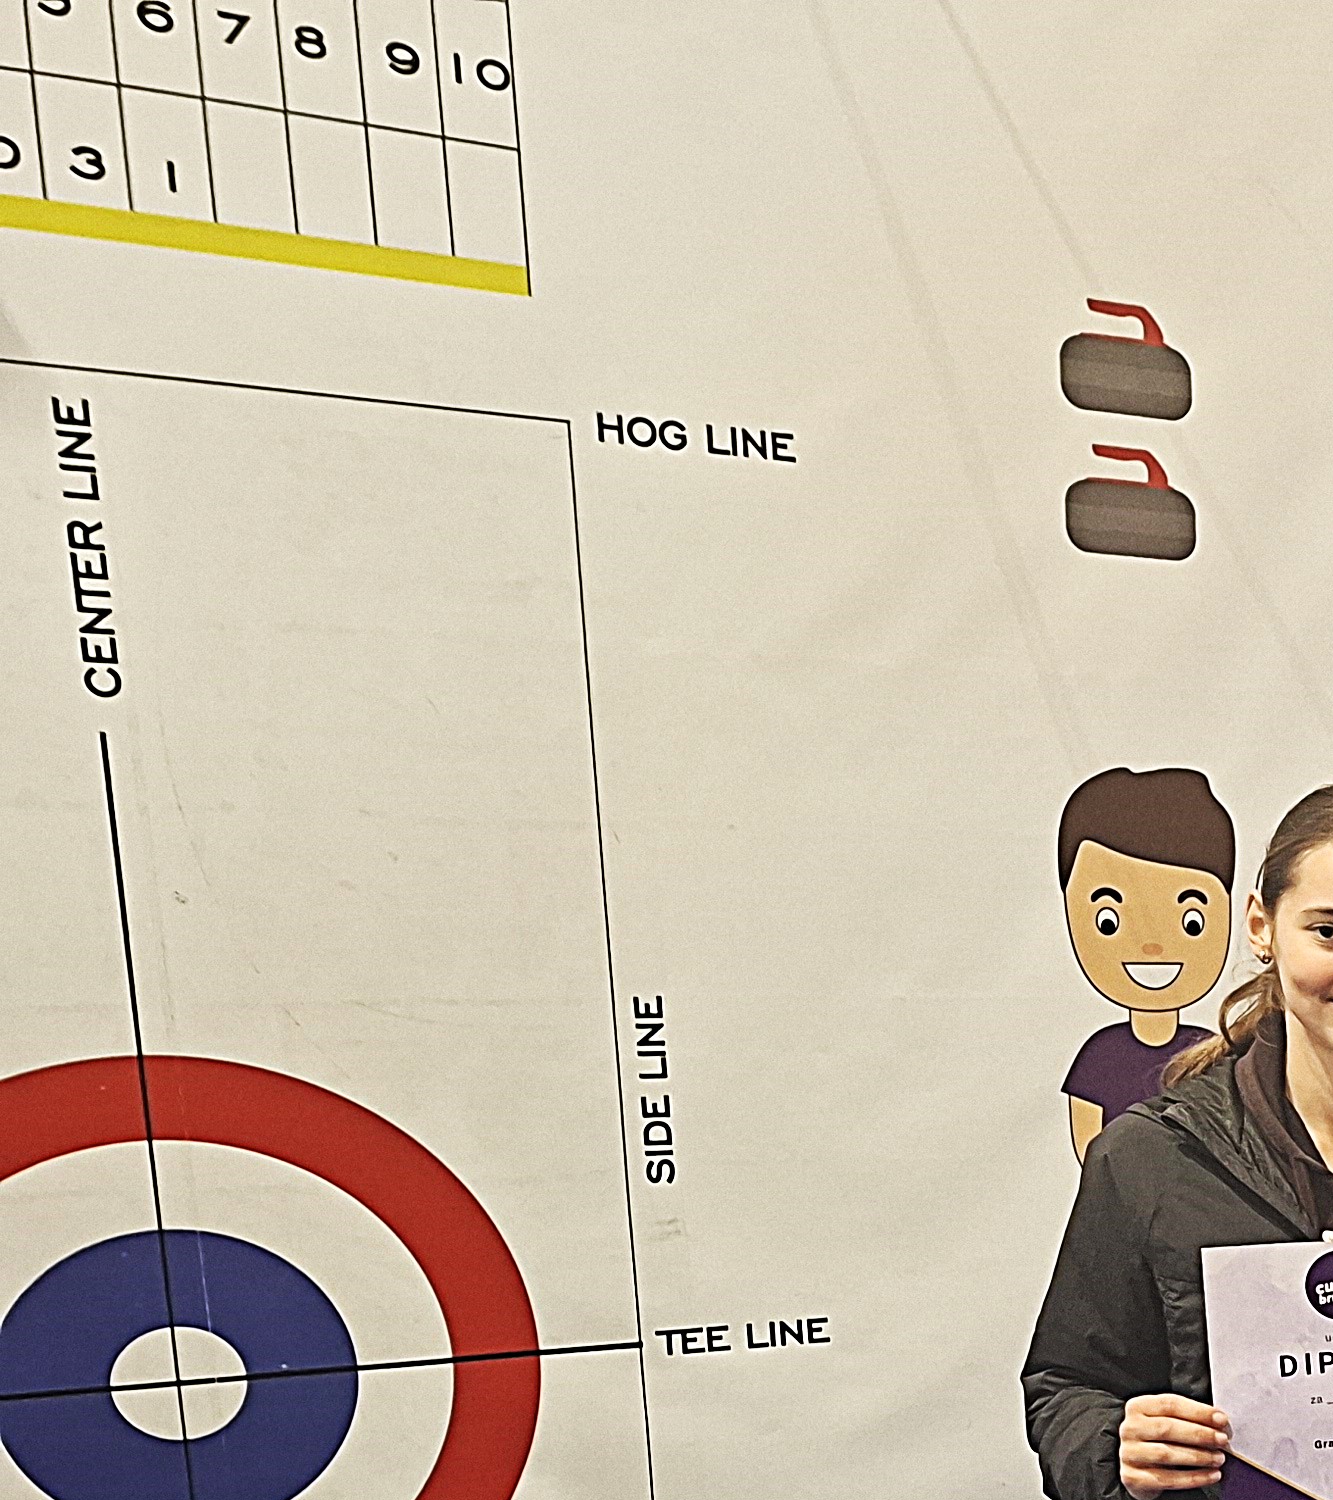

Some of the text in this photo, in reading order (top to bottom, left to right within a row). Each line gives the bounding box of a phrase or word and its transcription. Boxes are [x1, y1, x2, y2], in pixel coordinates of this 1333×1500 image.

[137, 0, 174, 33] 6
[218, 10, 251, 45] 7
[295, 26, 327, 59] 8
[386, 42, 420, 75] 9
[453, 53, 511, 91] 10
[69, 146, 106, 181] 3
[167, 160, 177, 193] 1
[596, 412, 797, 463] HOG LINE
[51, 396, 122, 698] CENTER LINE
[632, 995, 676, 1184] SIDE LINE
[654, 1317, 831, 1356] TEE LINE
[1310, 1395, 1324, 1405] za
